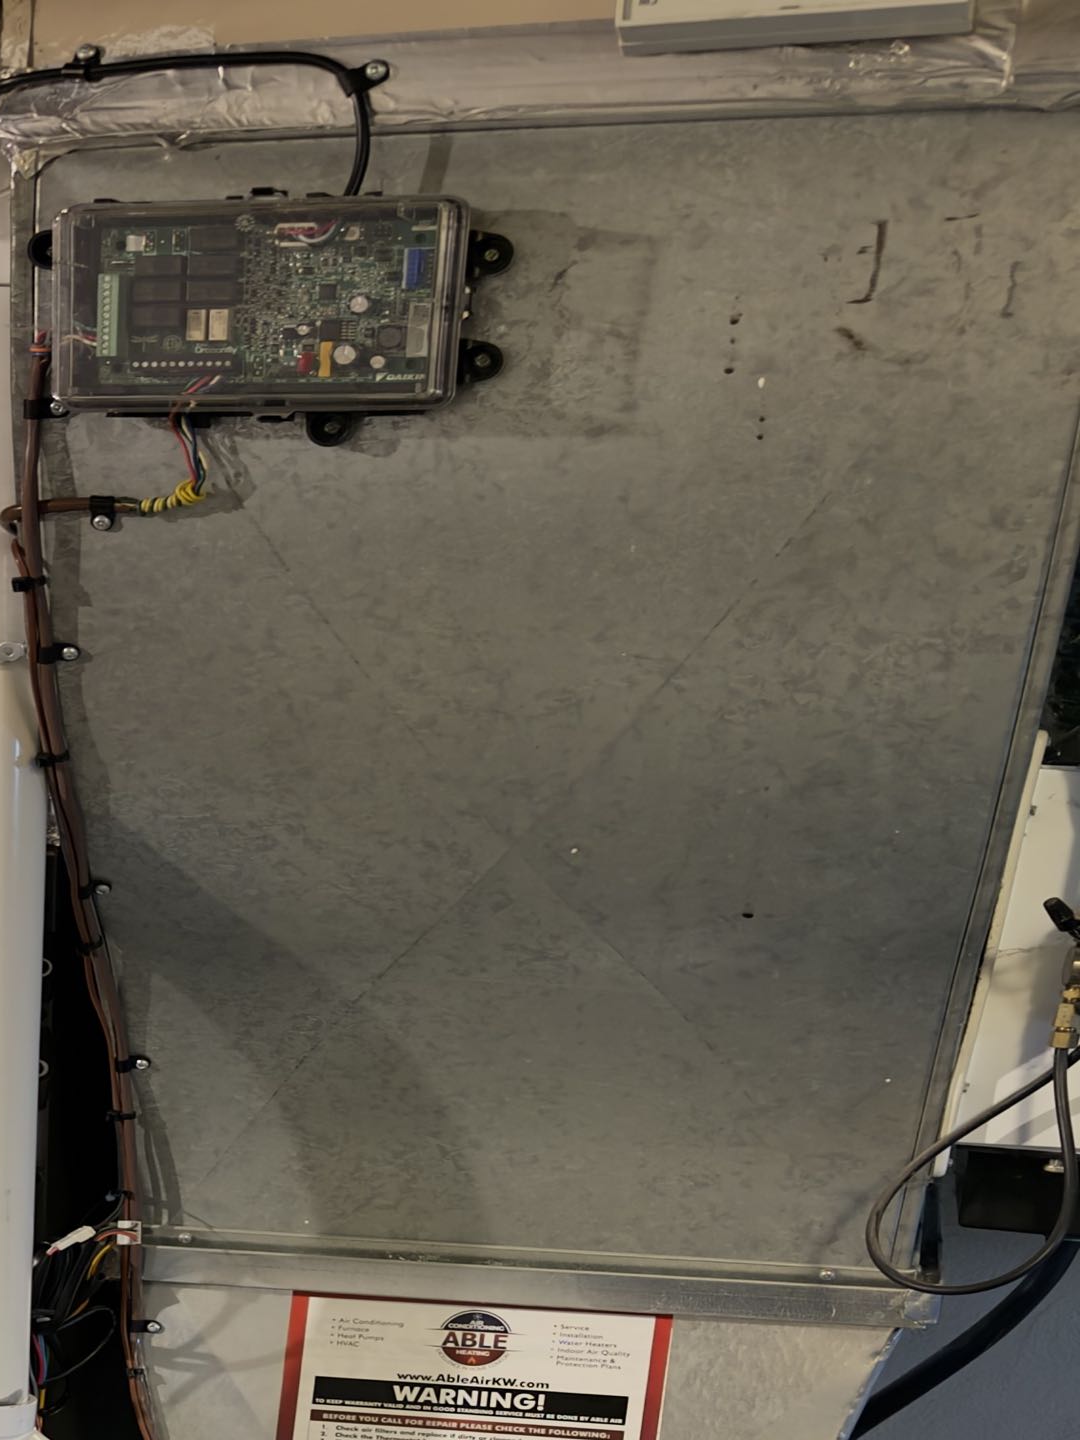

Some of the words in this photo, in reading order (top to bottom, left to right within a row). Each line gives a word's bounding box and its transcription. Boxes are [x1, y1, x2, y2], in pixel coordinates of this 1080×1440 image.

[448, 1322, 505, 1331] CONDITIONING
[441, 1331, 508, 1349] ABLE
[396, 1371, 549, 1389] www.AbleAirKW.com
[391, 1383, 545, 1411] WARNING!
[322, 1412, 356, 1420] BEFORE
[358, 1414, 378, 1422] YOU
[380, 1416, 402, 1424] CALL
[425, 1419, 457, 1428] REPAIR
[459, 1422, 492, 1431] PLEASE
[494, 1424, 525, 1433] CHECK
[527, 1427, 545, 1435] THE
[548, 1428, 610, 1439] FOLLOWING:
